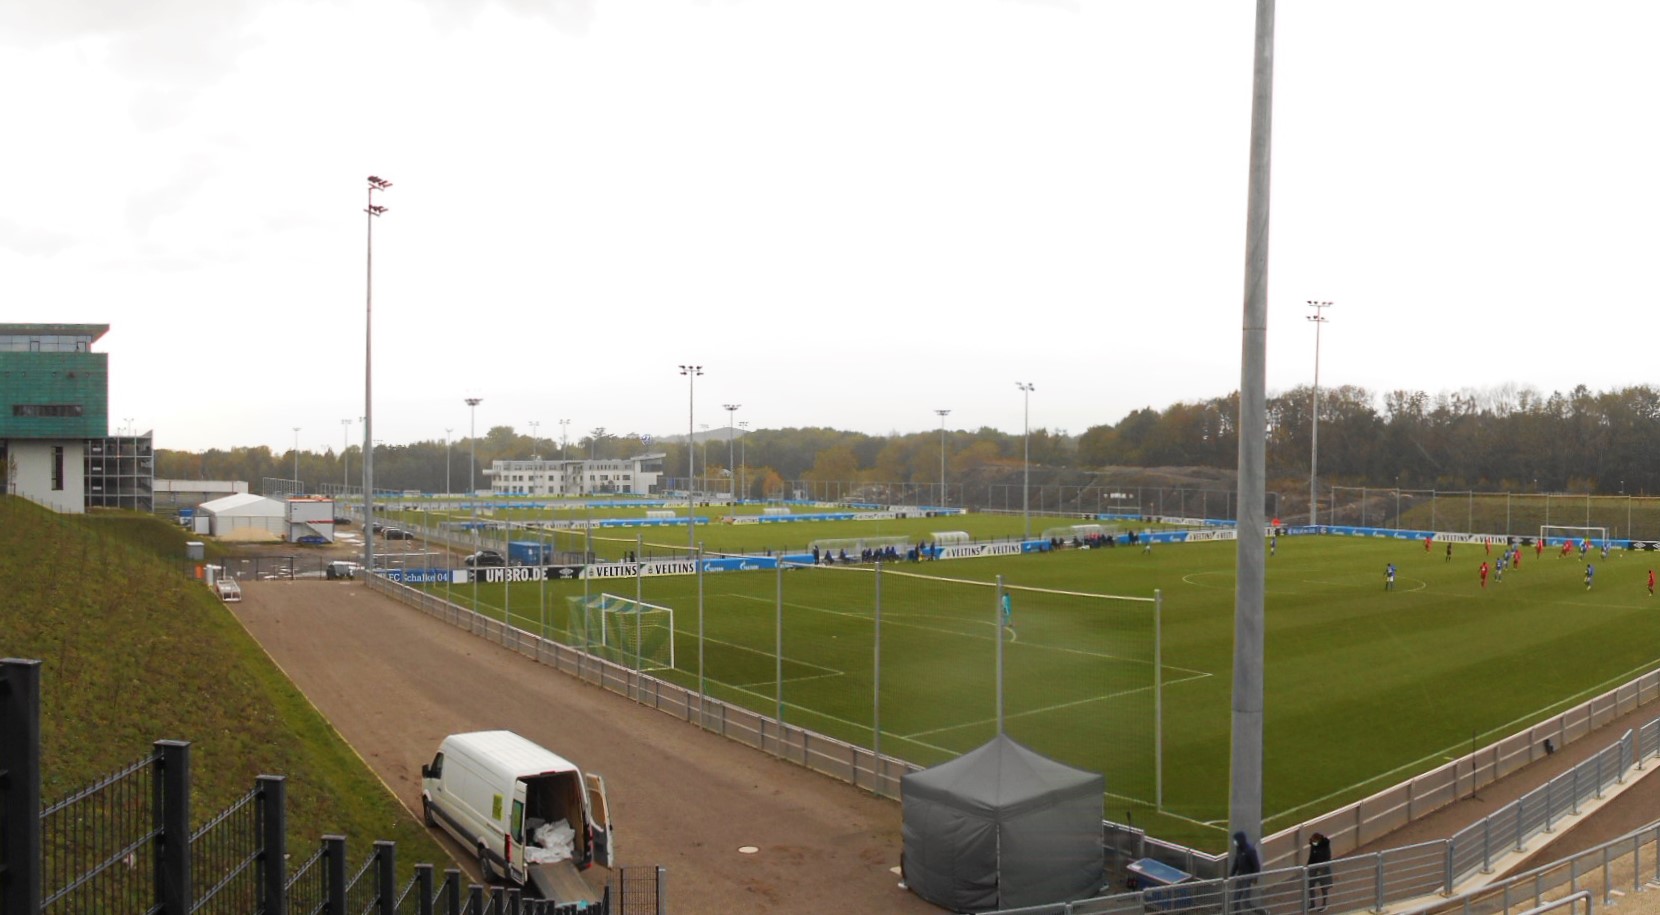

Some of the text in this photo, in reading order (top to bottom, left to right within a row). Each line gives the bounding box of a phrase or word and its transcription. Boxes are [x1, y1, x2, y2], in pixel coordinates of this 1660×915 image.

[1480, 535, 1507, 544] VETINS
[952, 547, 981, 557] VELTINS
[993, 544, 1020, 555] VELTINS
[597, 565, 637, 577] VELTINS
[656, 562, 695, 575] VELTINS
[437, 573, 448, 582] 04
[486, 567, 549, 583] UMBRO.DE
